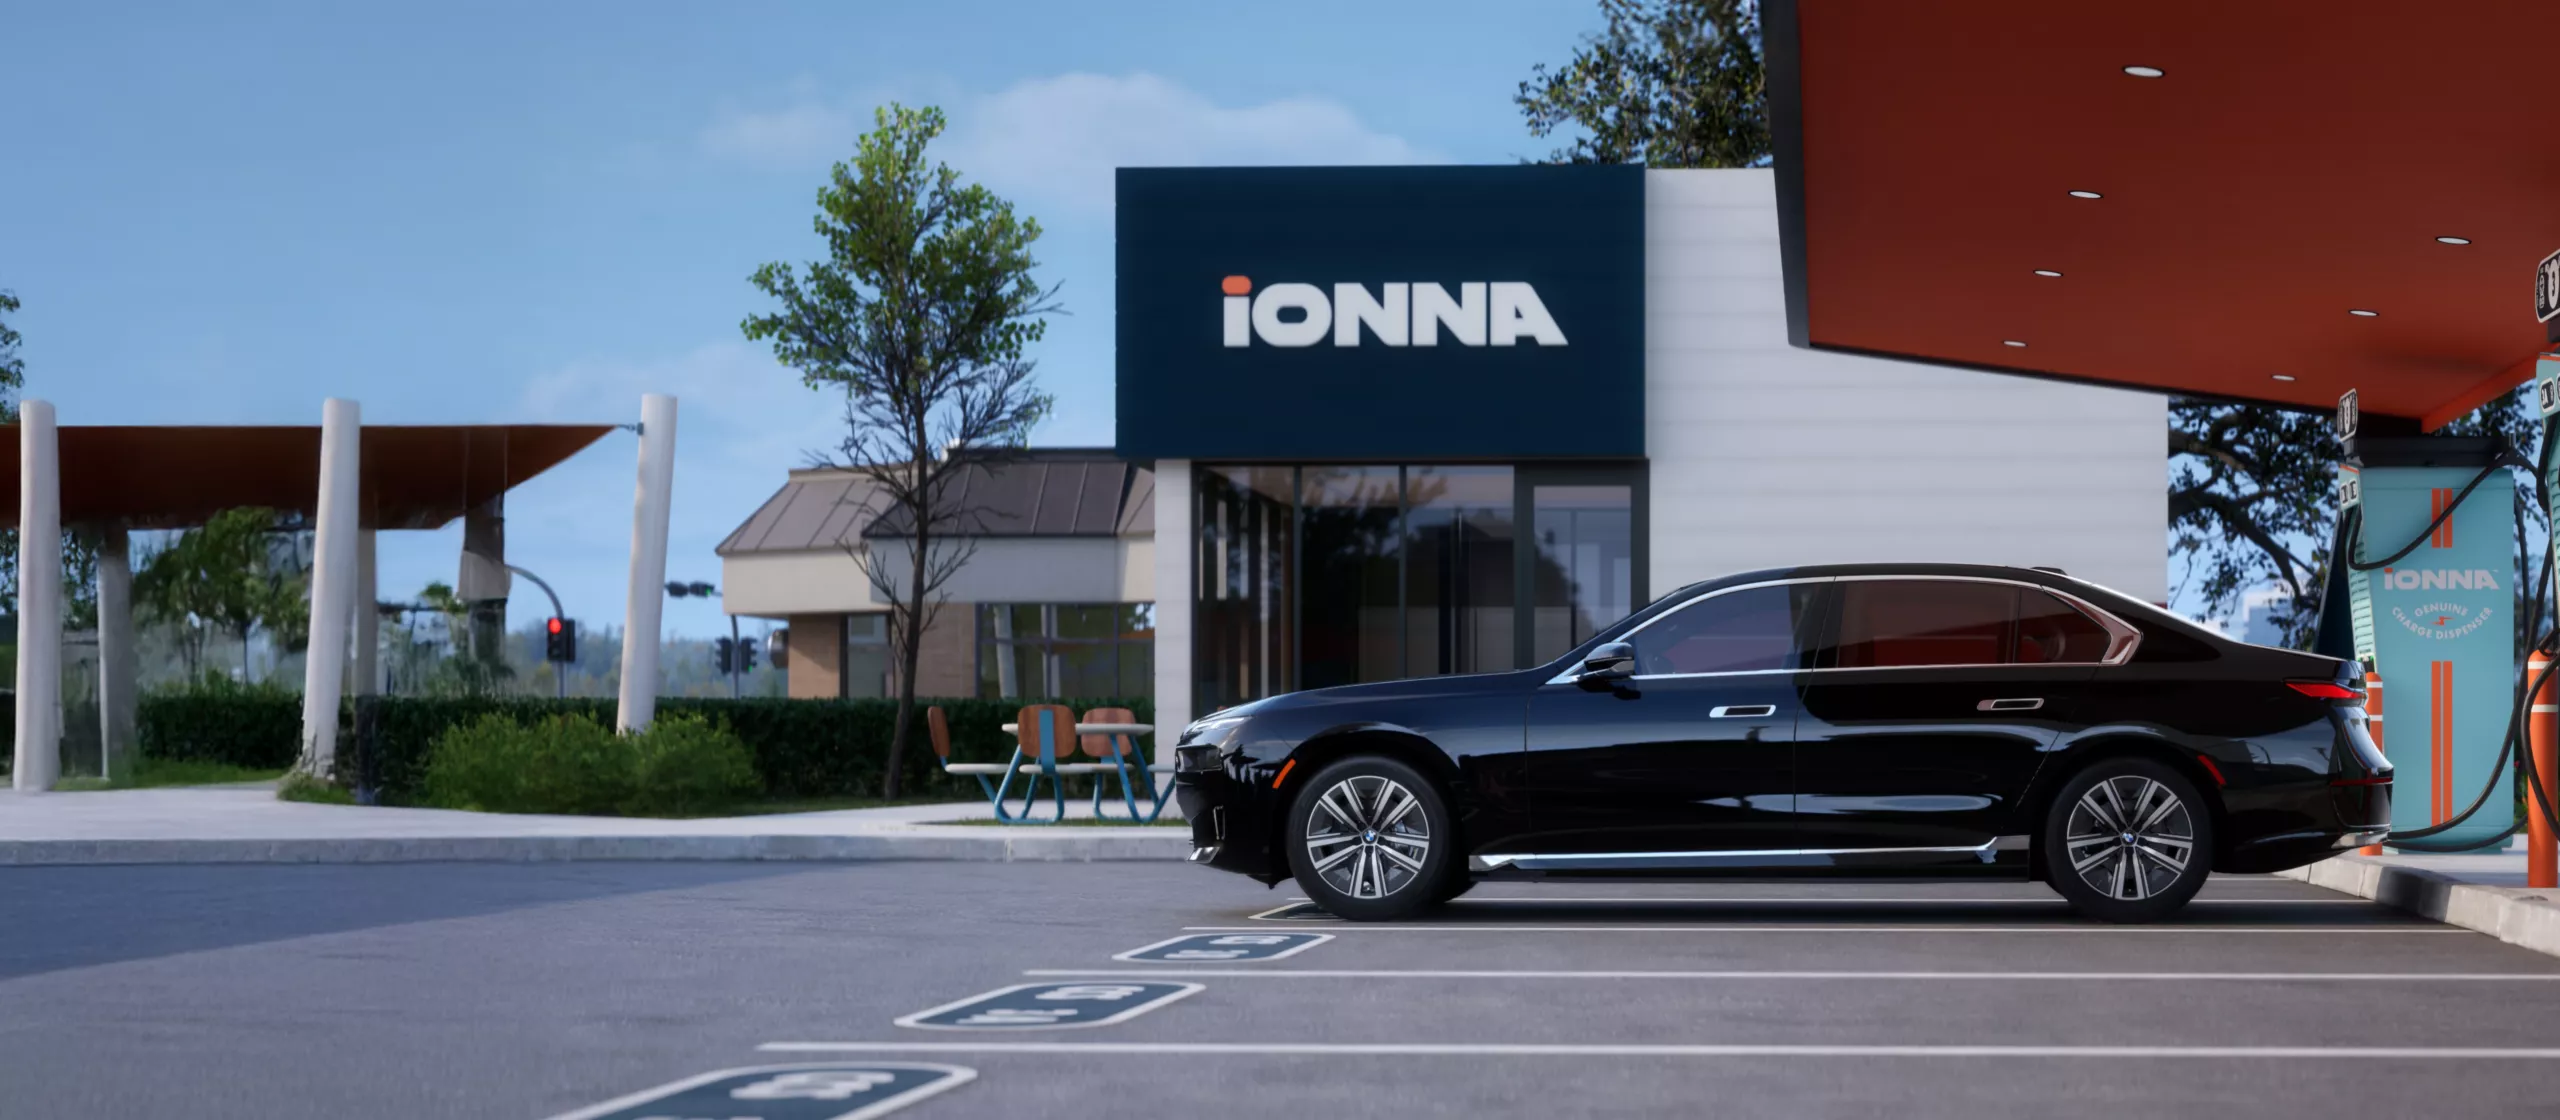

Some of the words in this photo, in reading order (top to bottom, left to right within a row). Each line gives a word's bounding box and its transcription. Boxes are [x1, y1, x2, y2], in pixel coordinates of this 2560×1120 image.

[2414, 602, 2468, 617] GENUINE
[2392, 607, 2433, 639] CHARGE
[2435, 607, 2493, 640] DISPENSER
